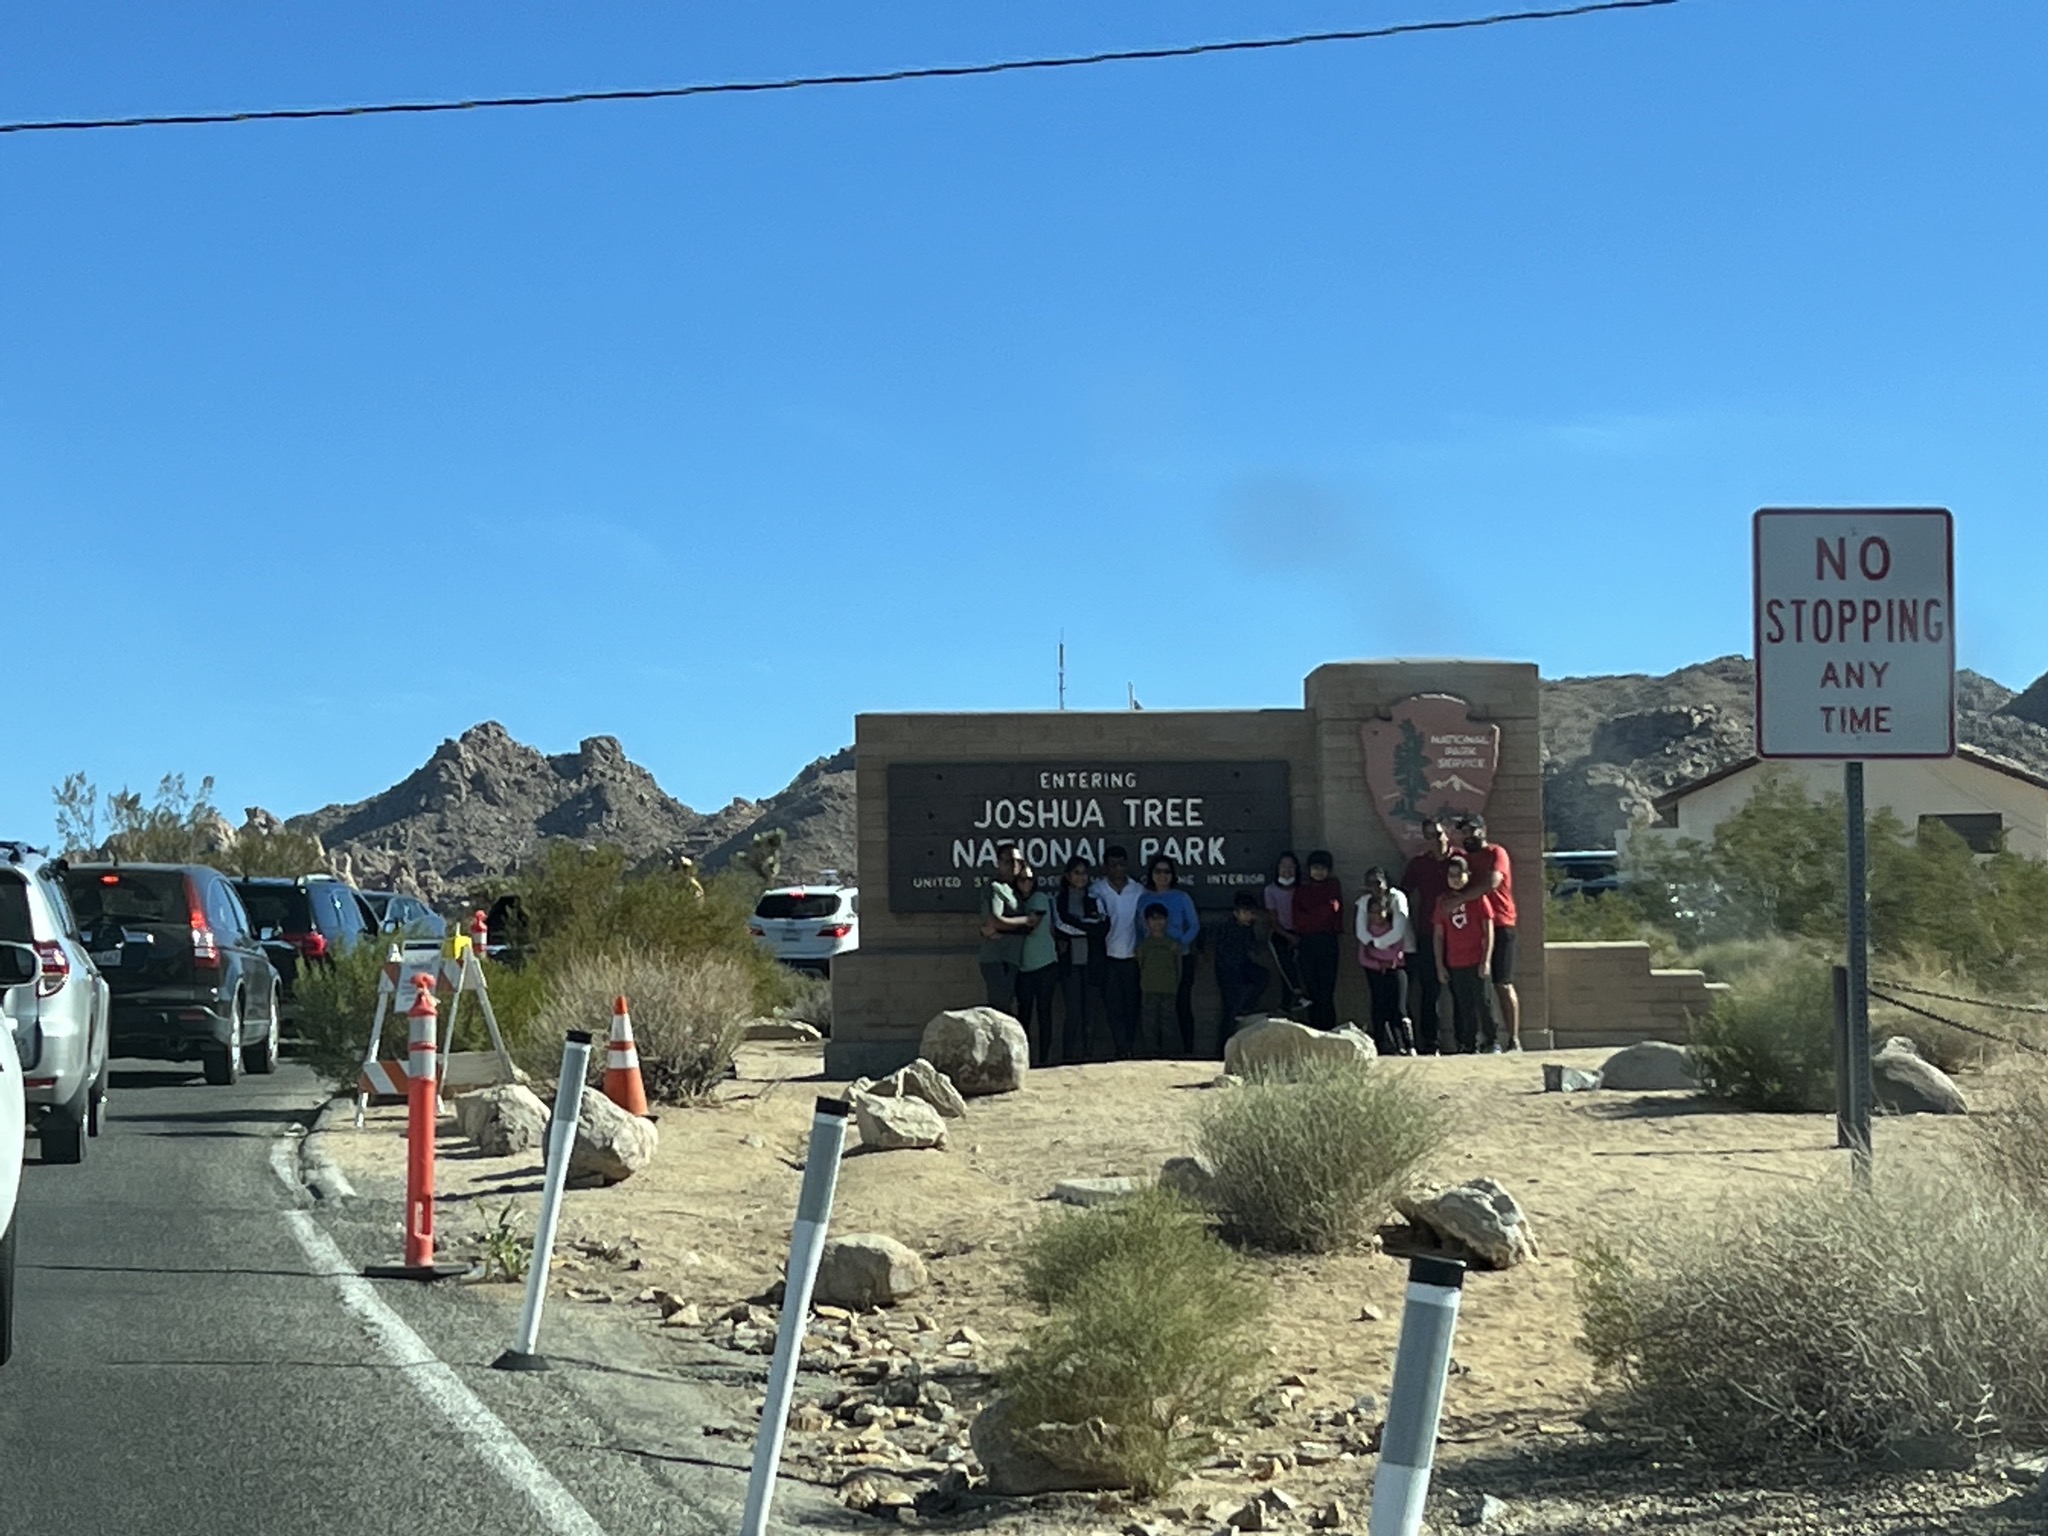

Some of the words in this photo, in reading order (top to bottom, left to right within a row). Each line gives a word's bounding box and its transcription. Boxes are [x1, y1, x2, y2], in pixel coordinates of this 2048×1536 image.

[1816, 536, 1891, 581] NO
[1765, 598, 1944, 644] STOPPING
[1820, 661, 1890, 689] ANY
[1820, 706, 1892, 734] TIME
[1040, 772, 1137, 789] ENTERING
[974, 799, 1105, 829] JOSHUA
[1123, 798, 1203, 827] TREE
[952, 837, 1105, 869] NAIONAL
[1140, 836, 1226, 867] PARK
[912, 876, 961, 888] UNITED
[1206, 873, 1265, 885] INTERIOR
